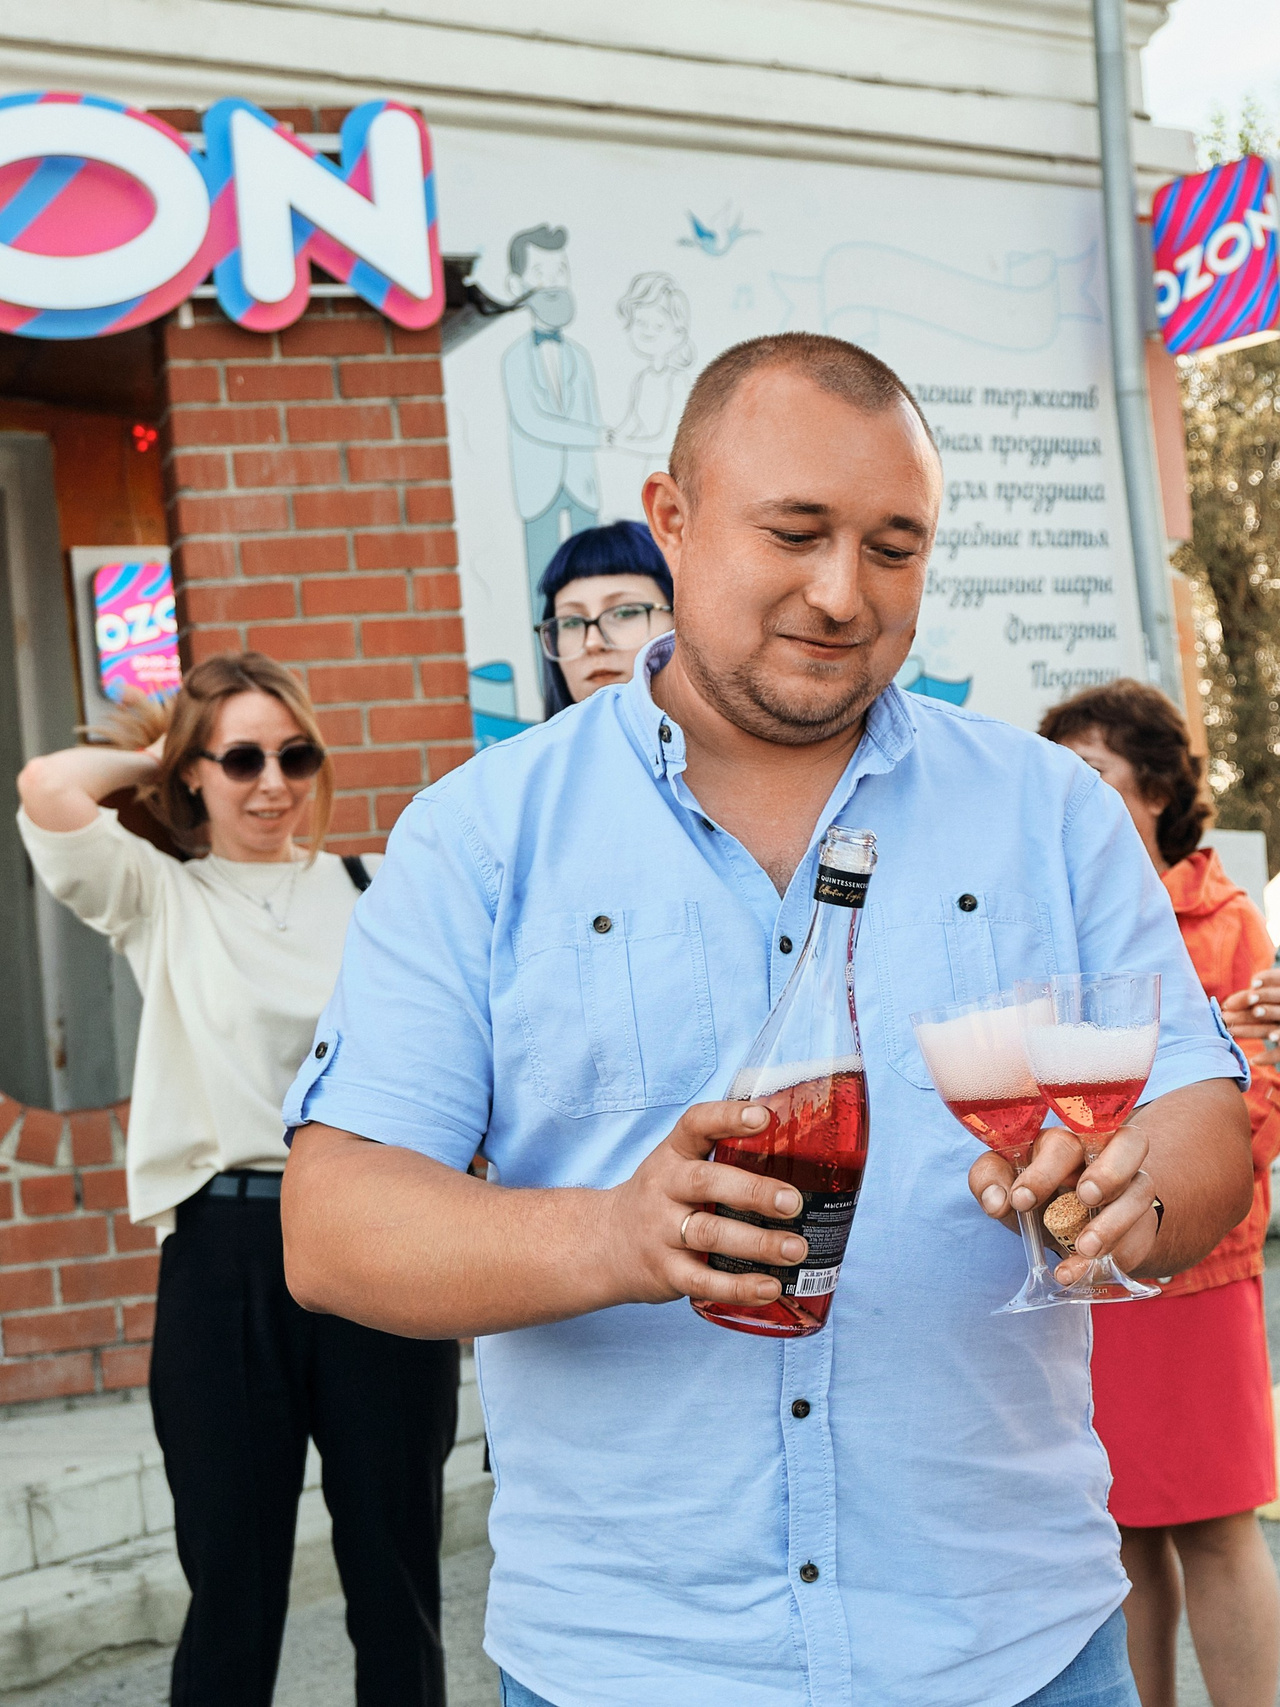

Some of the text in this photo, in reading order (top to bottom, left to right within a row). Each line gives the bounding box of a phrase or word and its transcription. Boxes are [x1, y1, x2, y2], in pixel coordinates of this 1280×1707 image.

[1153, 193, 1279, 320] OZON
[982, 384, 1100, 421] торжеств
[990, 434, 1102, 467] продукция
[946, 479, 1105, 514] для праздника
[1028, 528, 1110, 550] платья
[1053, 575, 1114, 607] шары
